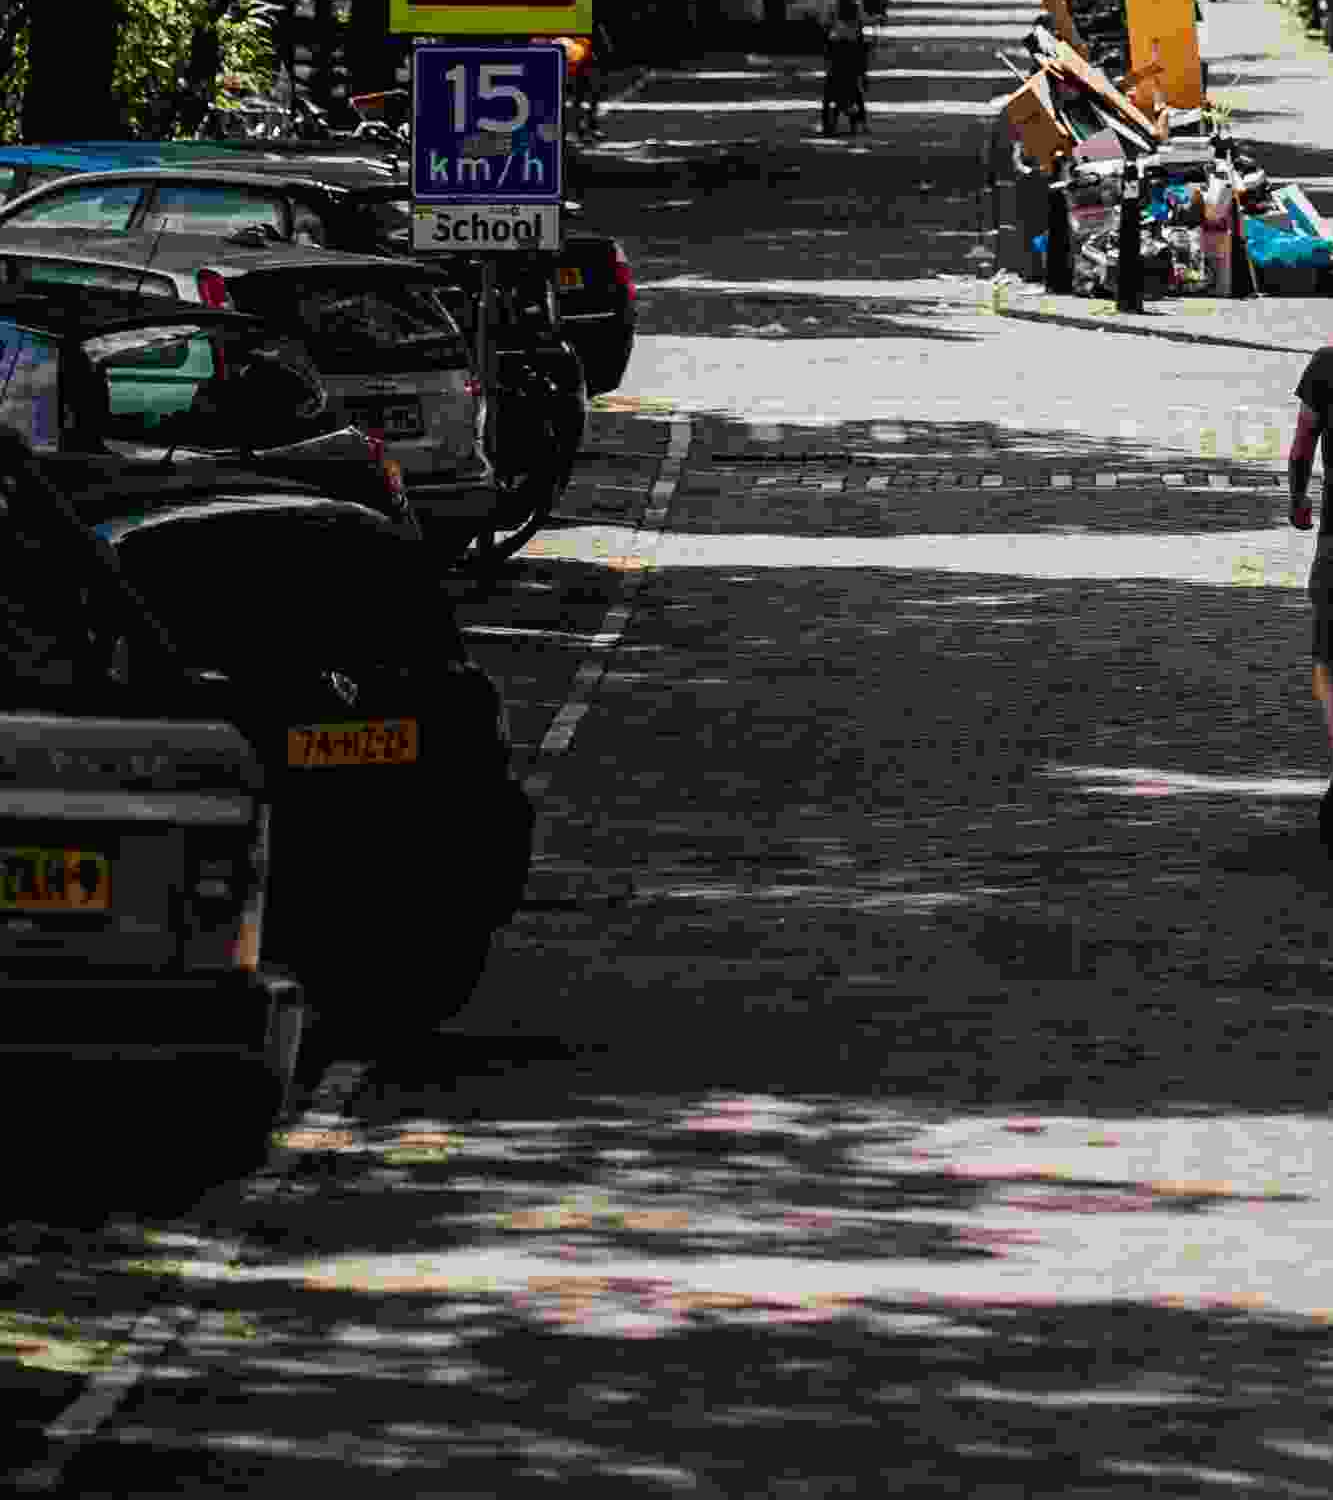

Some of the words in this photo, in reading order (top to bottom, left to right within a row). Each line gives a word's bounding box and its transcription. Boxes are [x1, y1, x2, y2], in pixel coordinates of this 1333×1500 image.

[444, 63, 530, 132] 15
[428, 151, 544, 187] km/h
[432, 212, 543, 242] School
